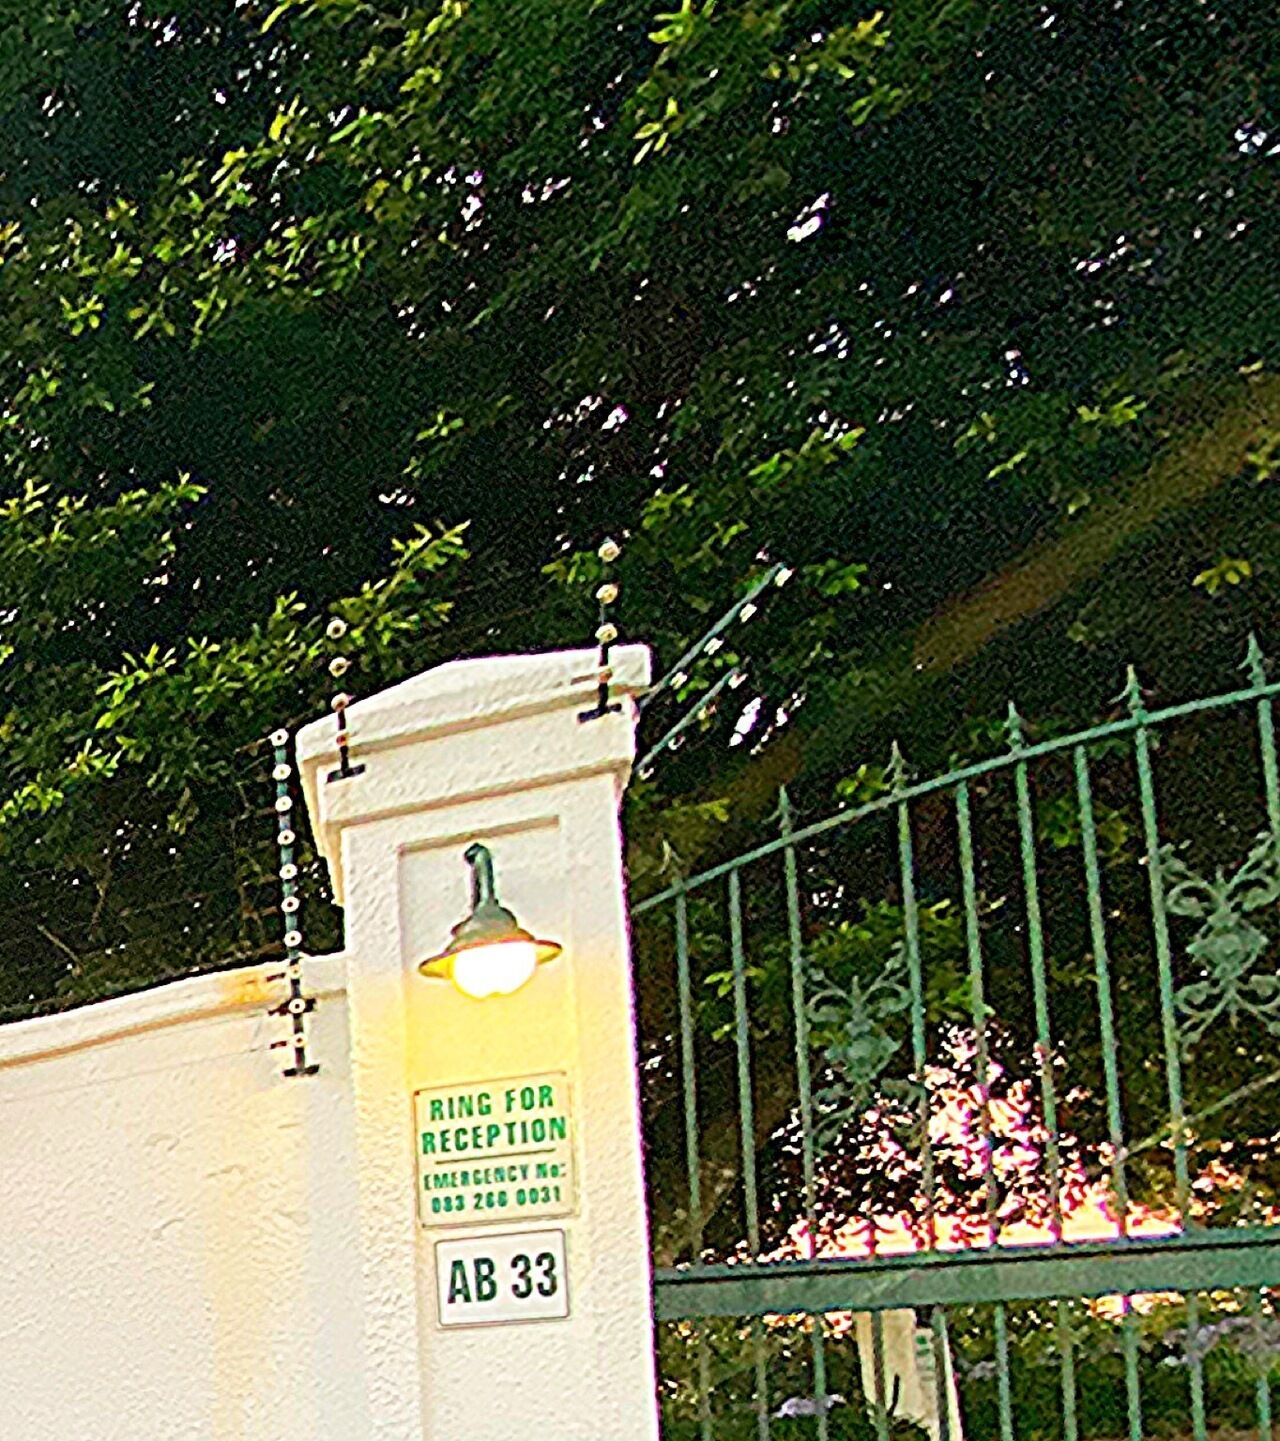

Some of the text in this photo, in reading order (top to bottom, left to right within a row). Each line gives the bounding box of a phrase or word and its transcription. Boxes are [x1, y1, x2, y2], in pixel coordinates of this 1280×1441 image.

[430, 1085, 554, 1122] RING FOR
[421, 1116, 567, 1155] RECEPTION
[424, 1164, 529, 1191] EMERGENCY
[447, 1252, 558, 1304] AB 33
